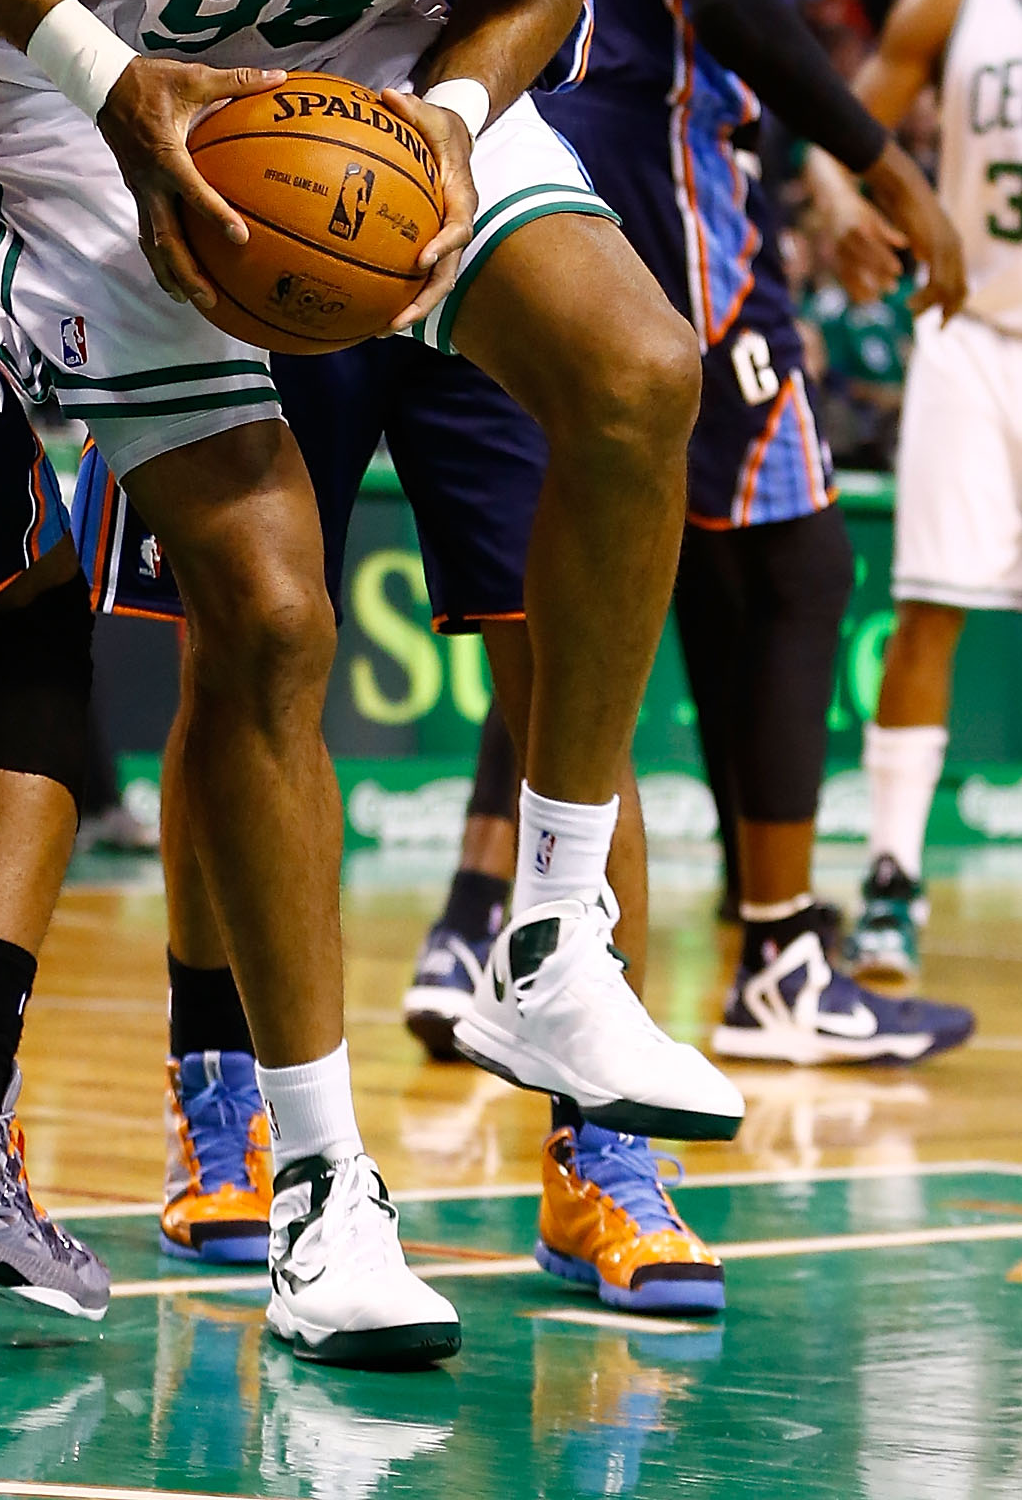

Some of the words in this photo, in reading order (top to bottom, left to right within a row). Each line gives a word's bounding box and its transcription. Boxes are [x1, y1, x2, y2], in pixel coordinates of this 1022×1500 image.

[969, 59, 1022, 135] CE
[273, 91, 437, 190] SPALDING
[263, 168, 292, 185] OFFICIAL
[292, 176, 313, 191] GAME
[312, 182, 329, 197] BALL
[330, 219, 351, 238] NBA
